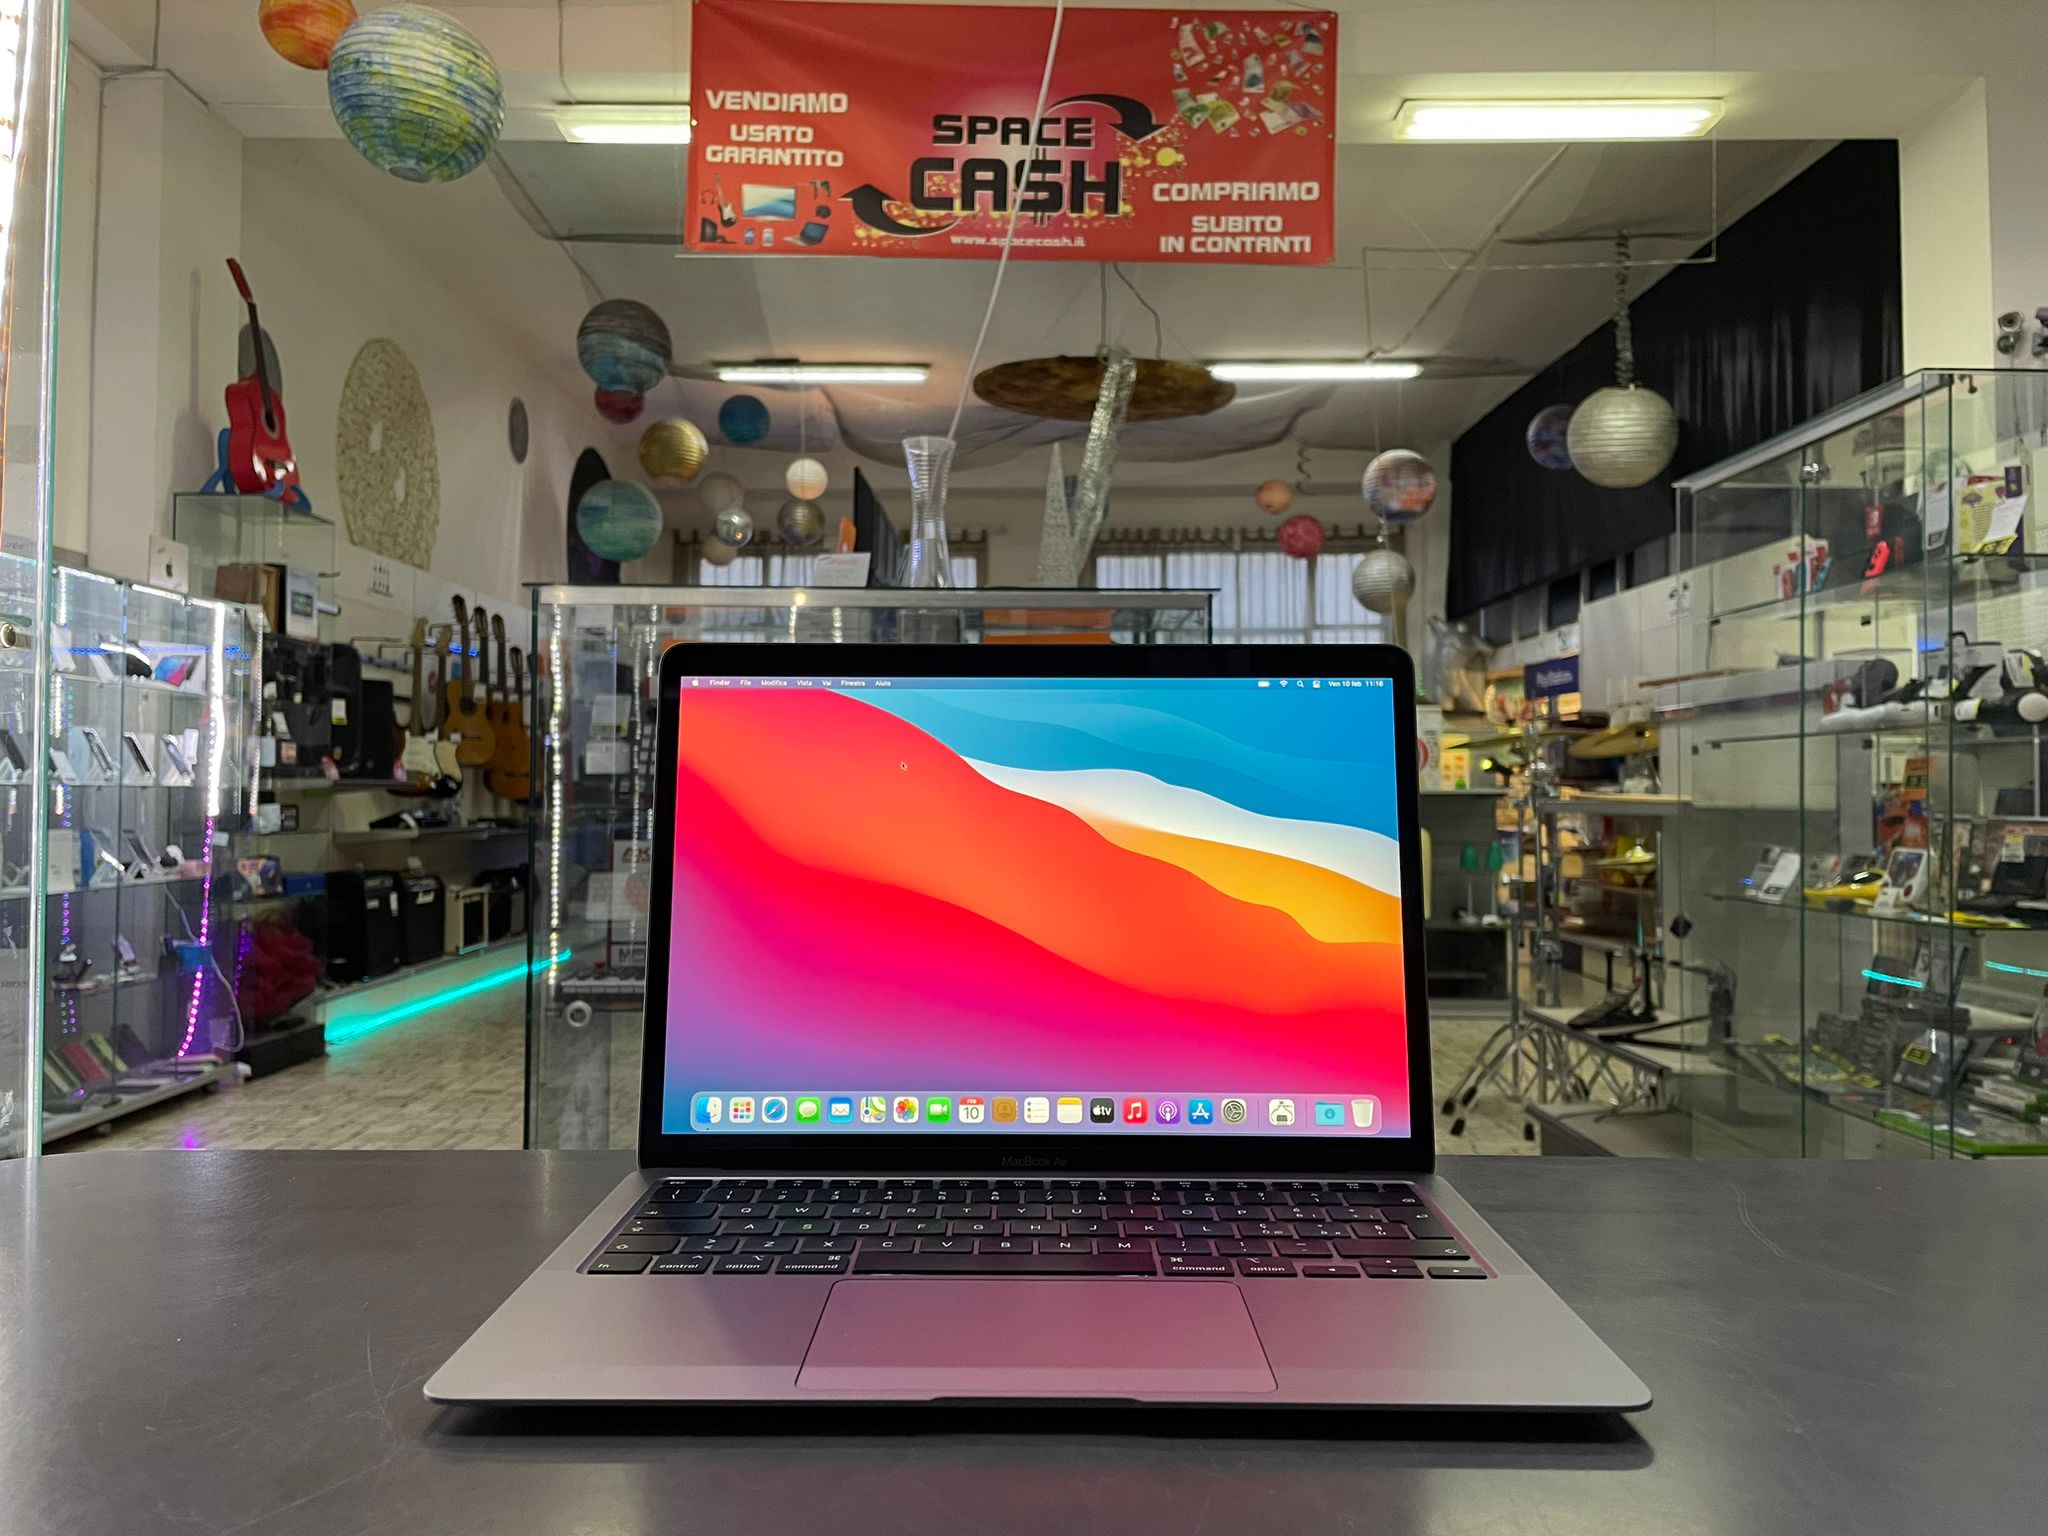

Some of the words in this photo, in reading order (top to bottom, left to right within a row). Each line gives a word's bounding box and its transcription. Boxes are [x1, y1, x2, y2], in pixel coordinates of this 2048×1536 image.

[705, 89, 848, 114] VENDIAMO
[730, 124, 814, 143] USATO
[933, 114, 1094, 149] SPACE
[705, 145, 844, 167] GARANTITO
[1152, 182, 1320, 202] COMPRIAMO
[1191, 215, 1283, 233] SUBITO
[1159, 236, 1184, 253] IN
[1190, 236, 1312, 253] CONTANTI
[963, 1106, 979, 1120] 10
[1101, 1106, 1112, 1116] tv
